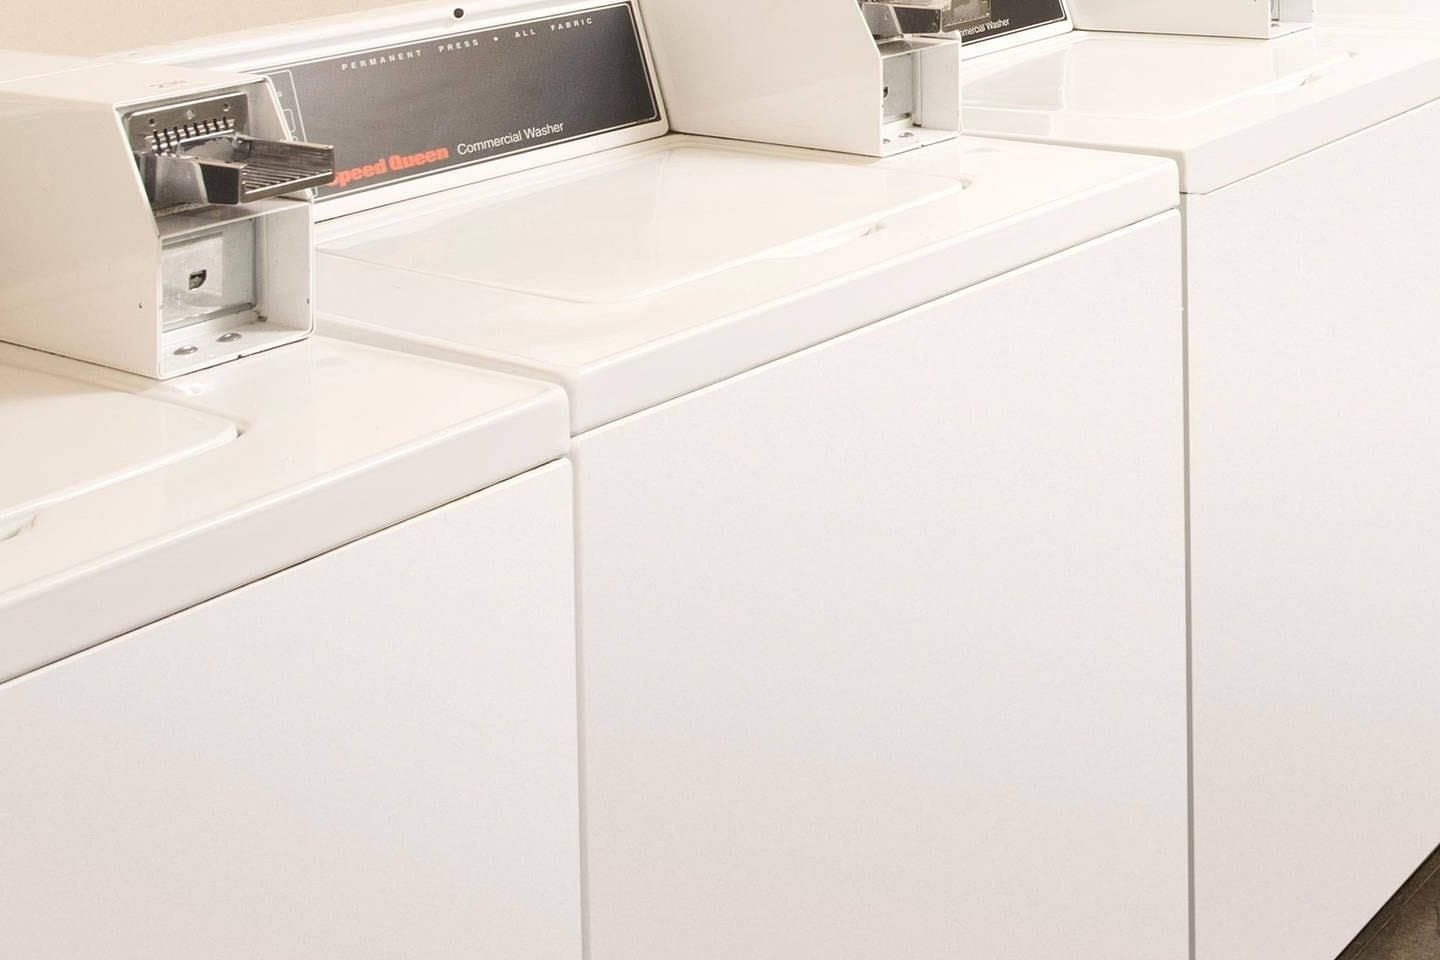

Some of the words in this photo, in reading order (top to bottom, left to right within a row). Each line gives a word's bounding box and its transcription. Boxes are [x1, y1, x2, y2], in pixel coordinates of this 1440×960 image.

[341, 48, 422, 71] PERMANENT
[438, 38, 480, 53] PRESS
[514, 28, 537, 39] ALL
[550, 16, 594, 32] FABRIC
[985, 18, 1010, 31] Washer
[388, 146, 449, 172] Queen
[456, 129, 522, 157] Commercial
[523, 120, 565, 143] Washer
